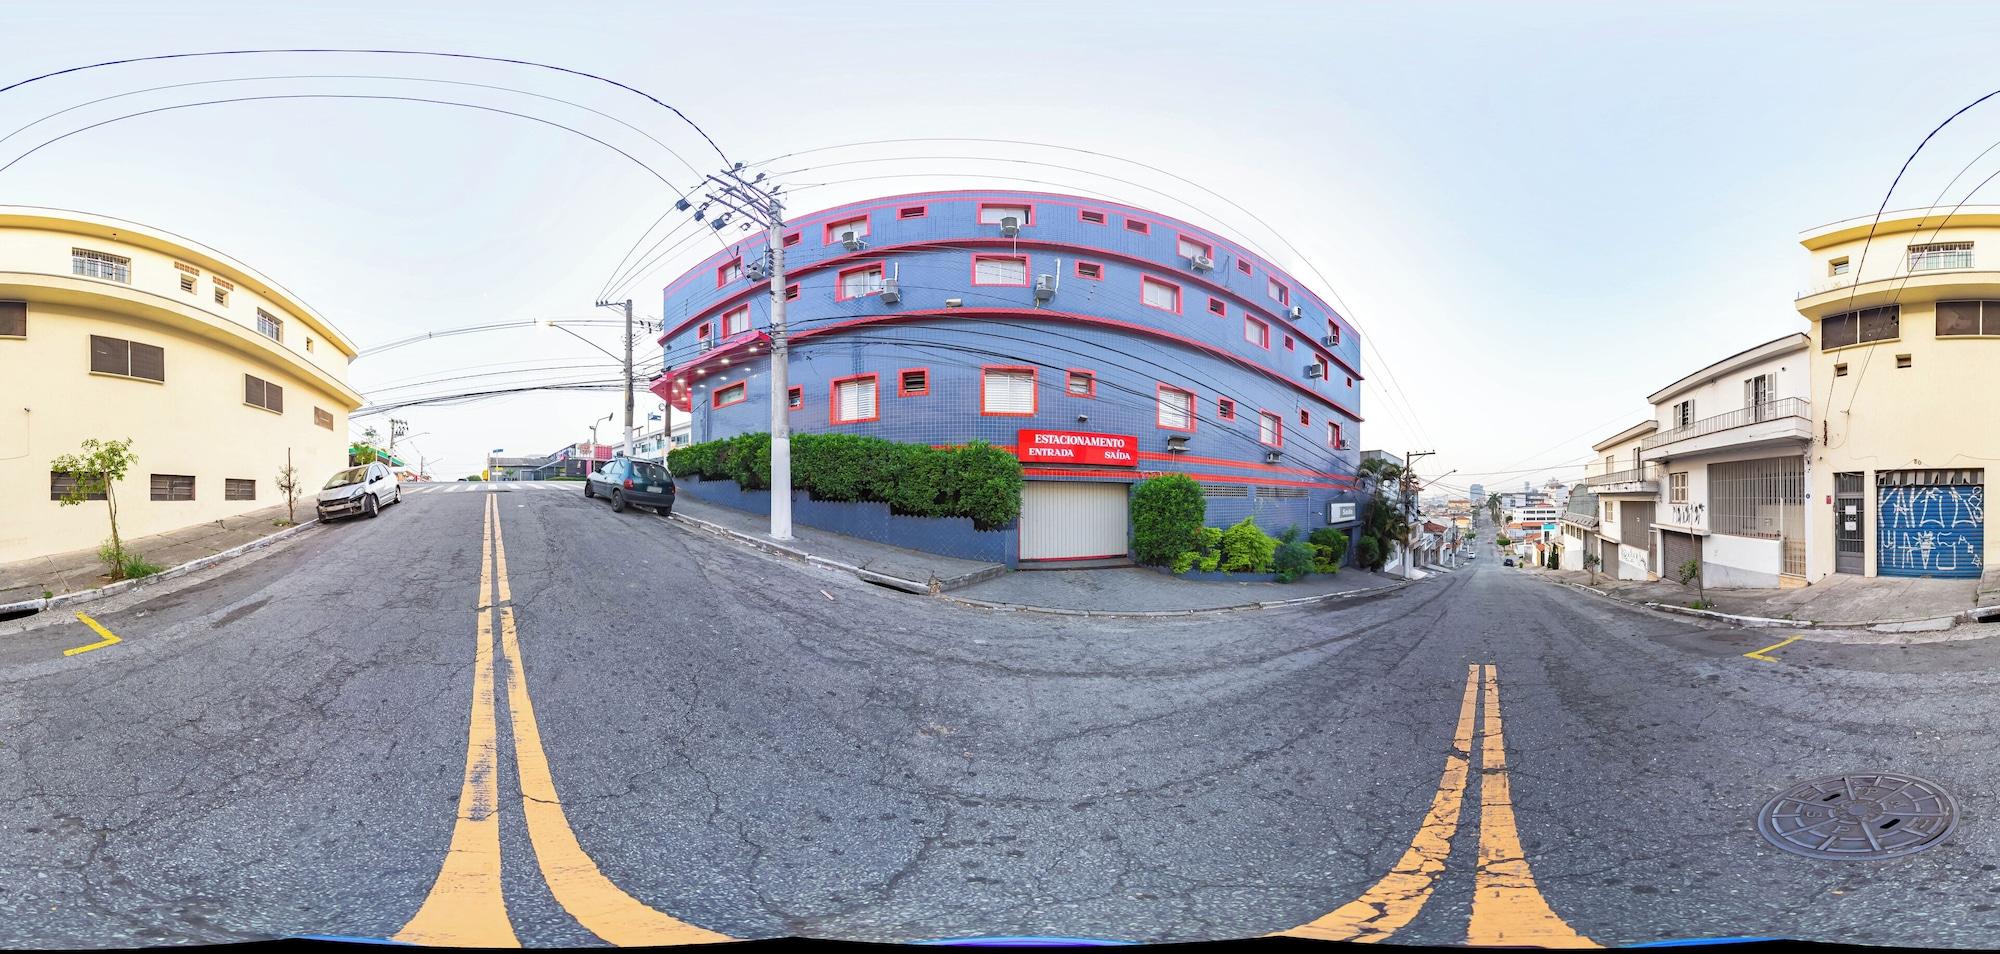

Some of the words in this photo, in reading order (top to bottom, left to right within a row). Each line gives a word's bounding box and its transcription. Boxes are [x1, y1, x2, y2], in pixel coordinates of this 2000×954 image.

[1035, 434, 1125, 448] ESTACIONAMENTO
[1029, 447, 1074, 457] ENTRADA
[1104, 449, 1131, 460] SAÍDA
